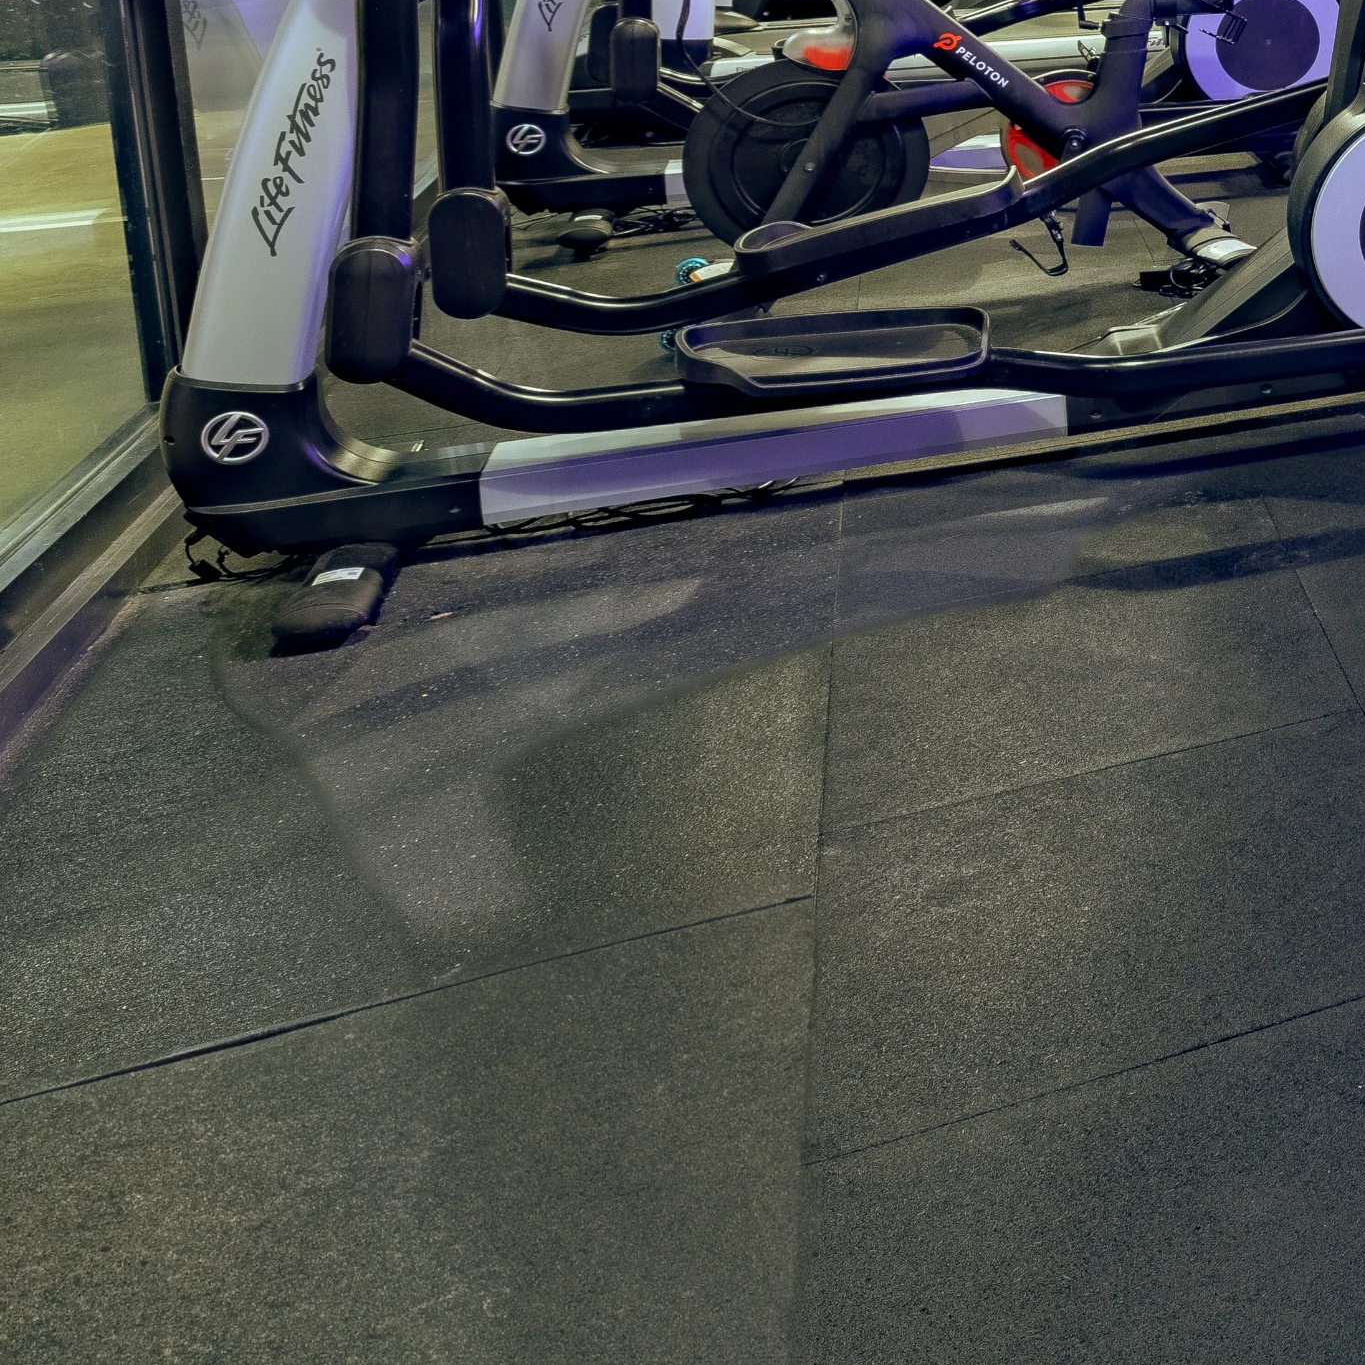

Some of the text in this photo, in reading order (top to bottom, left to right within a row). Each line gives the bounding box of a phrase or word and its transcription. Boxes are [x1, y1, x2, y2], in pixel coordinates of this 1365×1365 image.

[955, 46, 1010, 88] PELOTON
[251, 51, 336, 258] Life Fitness
